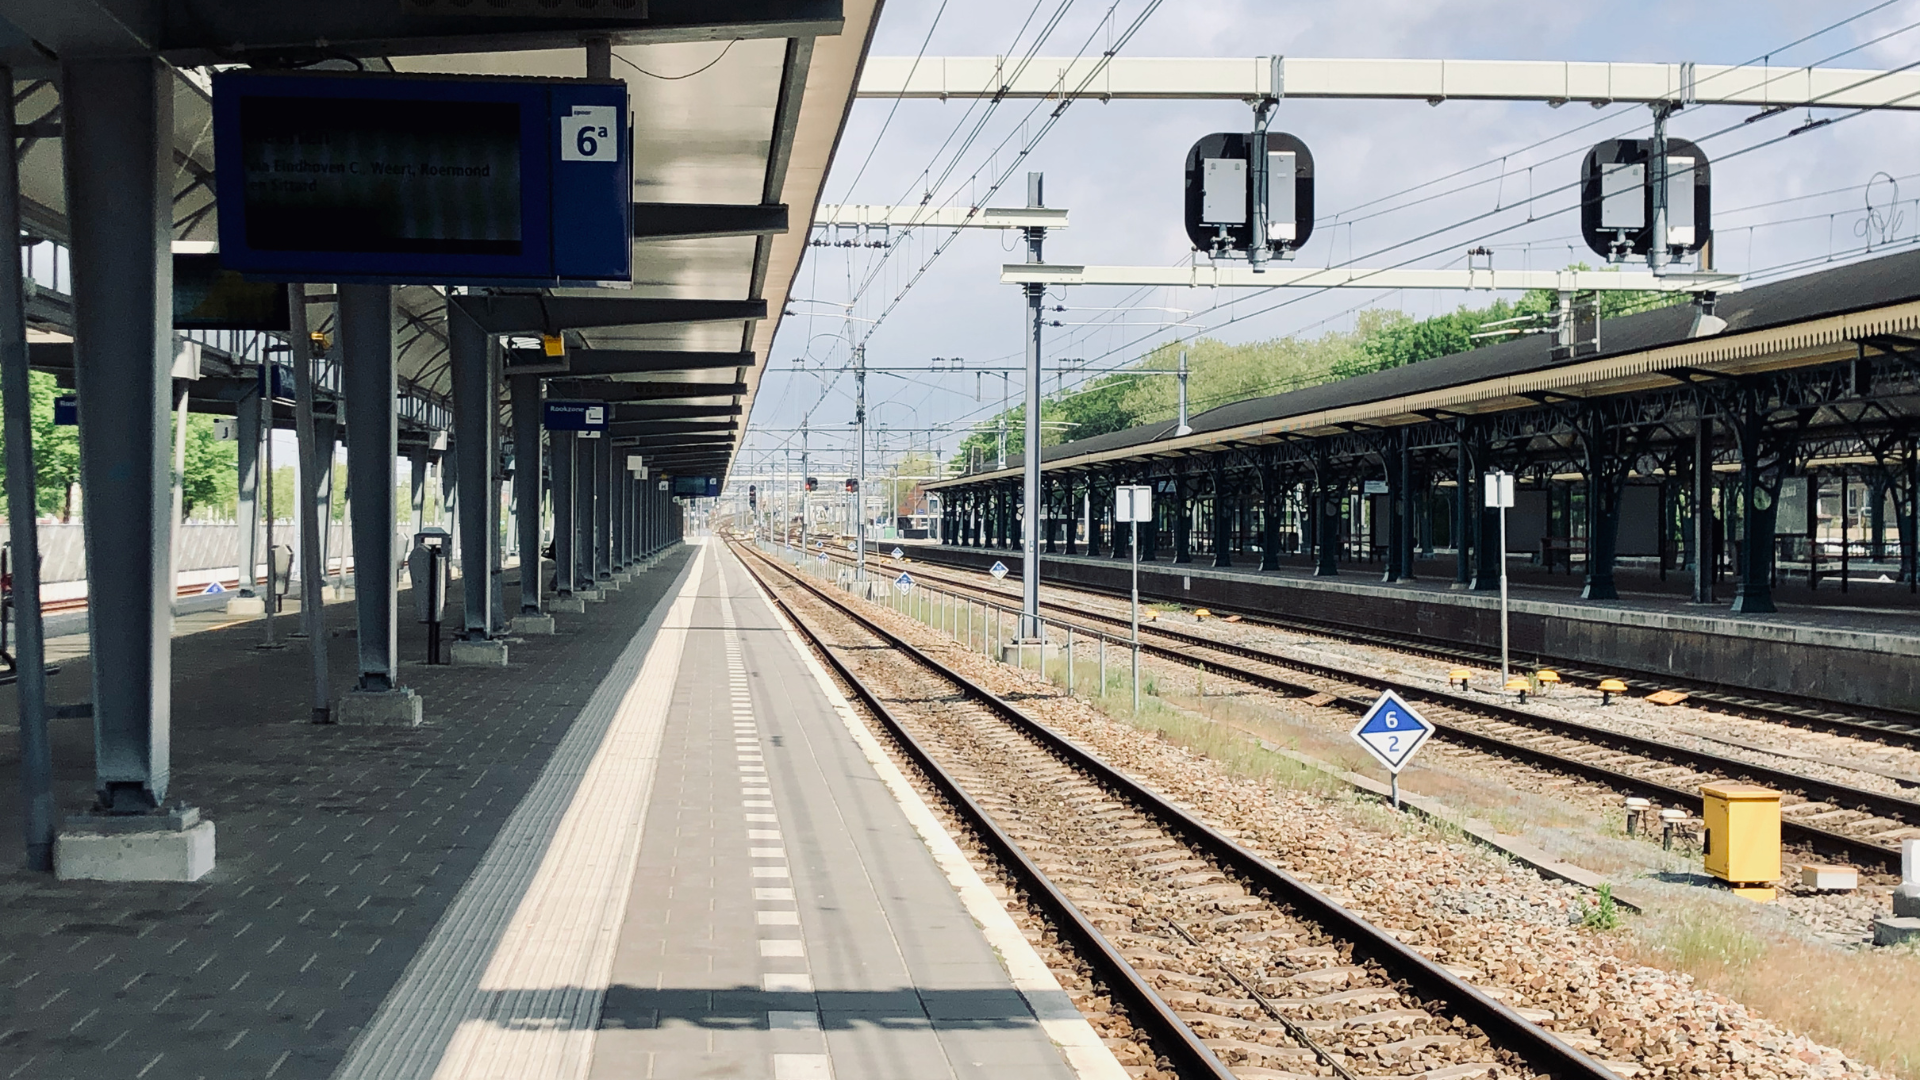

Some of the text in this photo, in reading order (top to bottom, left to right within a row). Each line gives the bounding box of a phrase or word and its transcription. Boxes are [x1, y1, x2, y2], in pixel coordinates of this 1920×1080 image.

[274, 159, 345, 174] Eindhoven
[370, 161, 416, 177] Weert,
[420, 162, 490, 177] Roermond
[271, 178, 317, 192] Sittard
[550, 405, 585, 413] Rookzone
[1385, 711, 1399, 729] 6
[1388, 736, 1400, 752] 2
